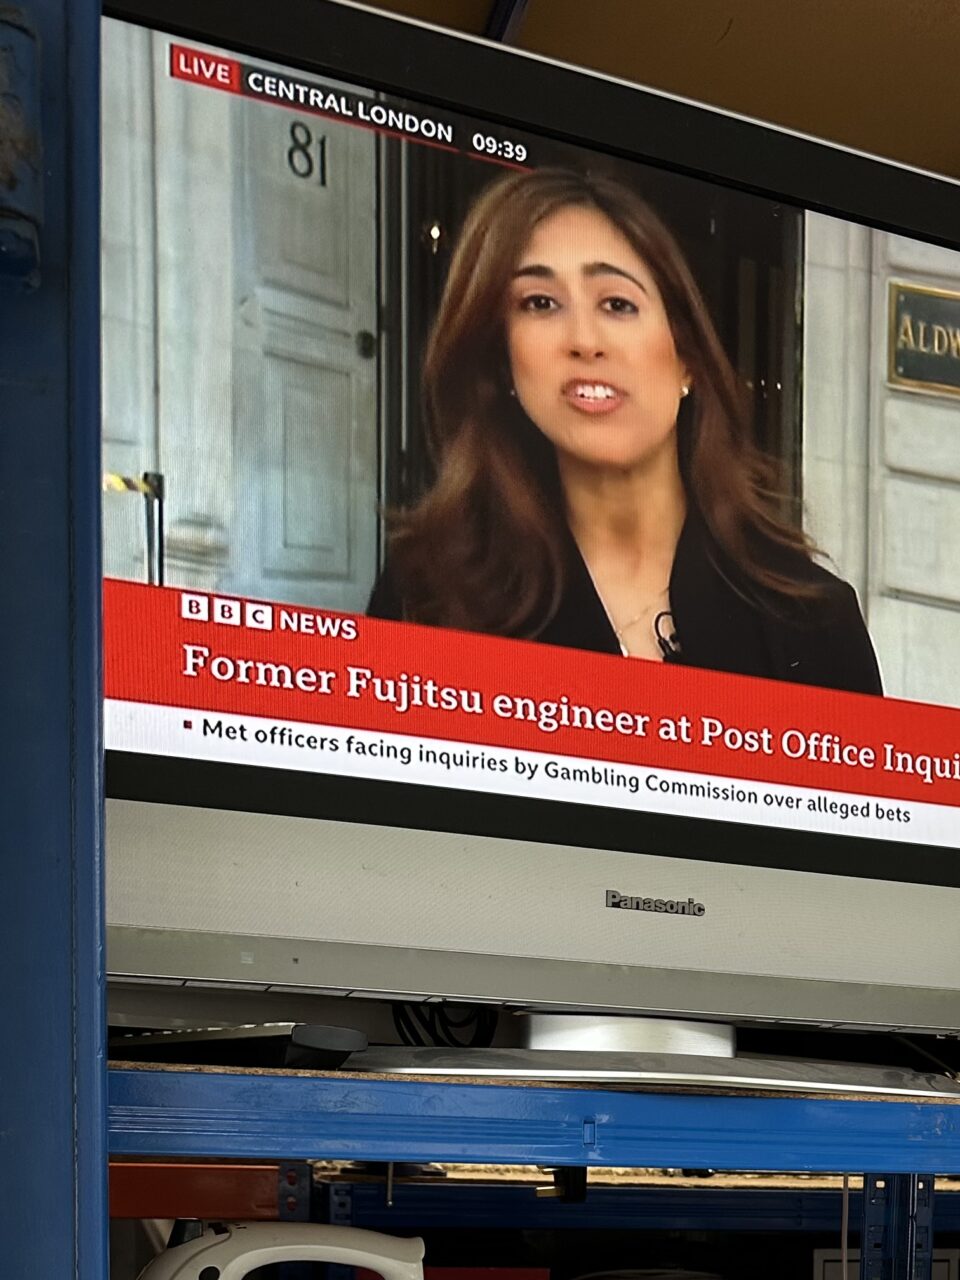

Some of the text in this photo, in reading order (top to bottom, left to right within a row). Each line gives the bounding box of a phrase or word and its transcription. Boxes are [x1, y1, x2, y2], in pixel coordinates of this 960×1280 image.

[177, 52, 231, 84] LIVE
[247, 72, 528, 162] CENTRAL LONDON 09:39
[287, 121, 327, 187] 81
[280, 609, 358, 640] NEWS
[182, 643, 336, 694] Former
[346, 666, 484, 714] Fujitsu
[494, 692, 650, 737] engineer
[659, 717, 692, 743] at
[702, 717, 774, 755] Post
[782, 729, 875, 770] Office
[202, 718, 912, 825] Met officers facing inquiries by Gambling Commission over alleged bets
[605, 890, 706, 918] Panasonic
